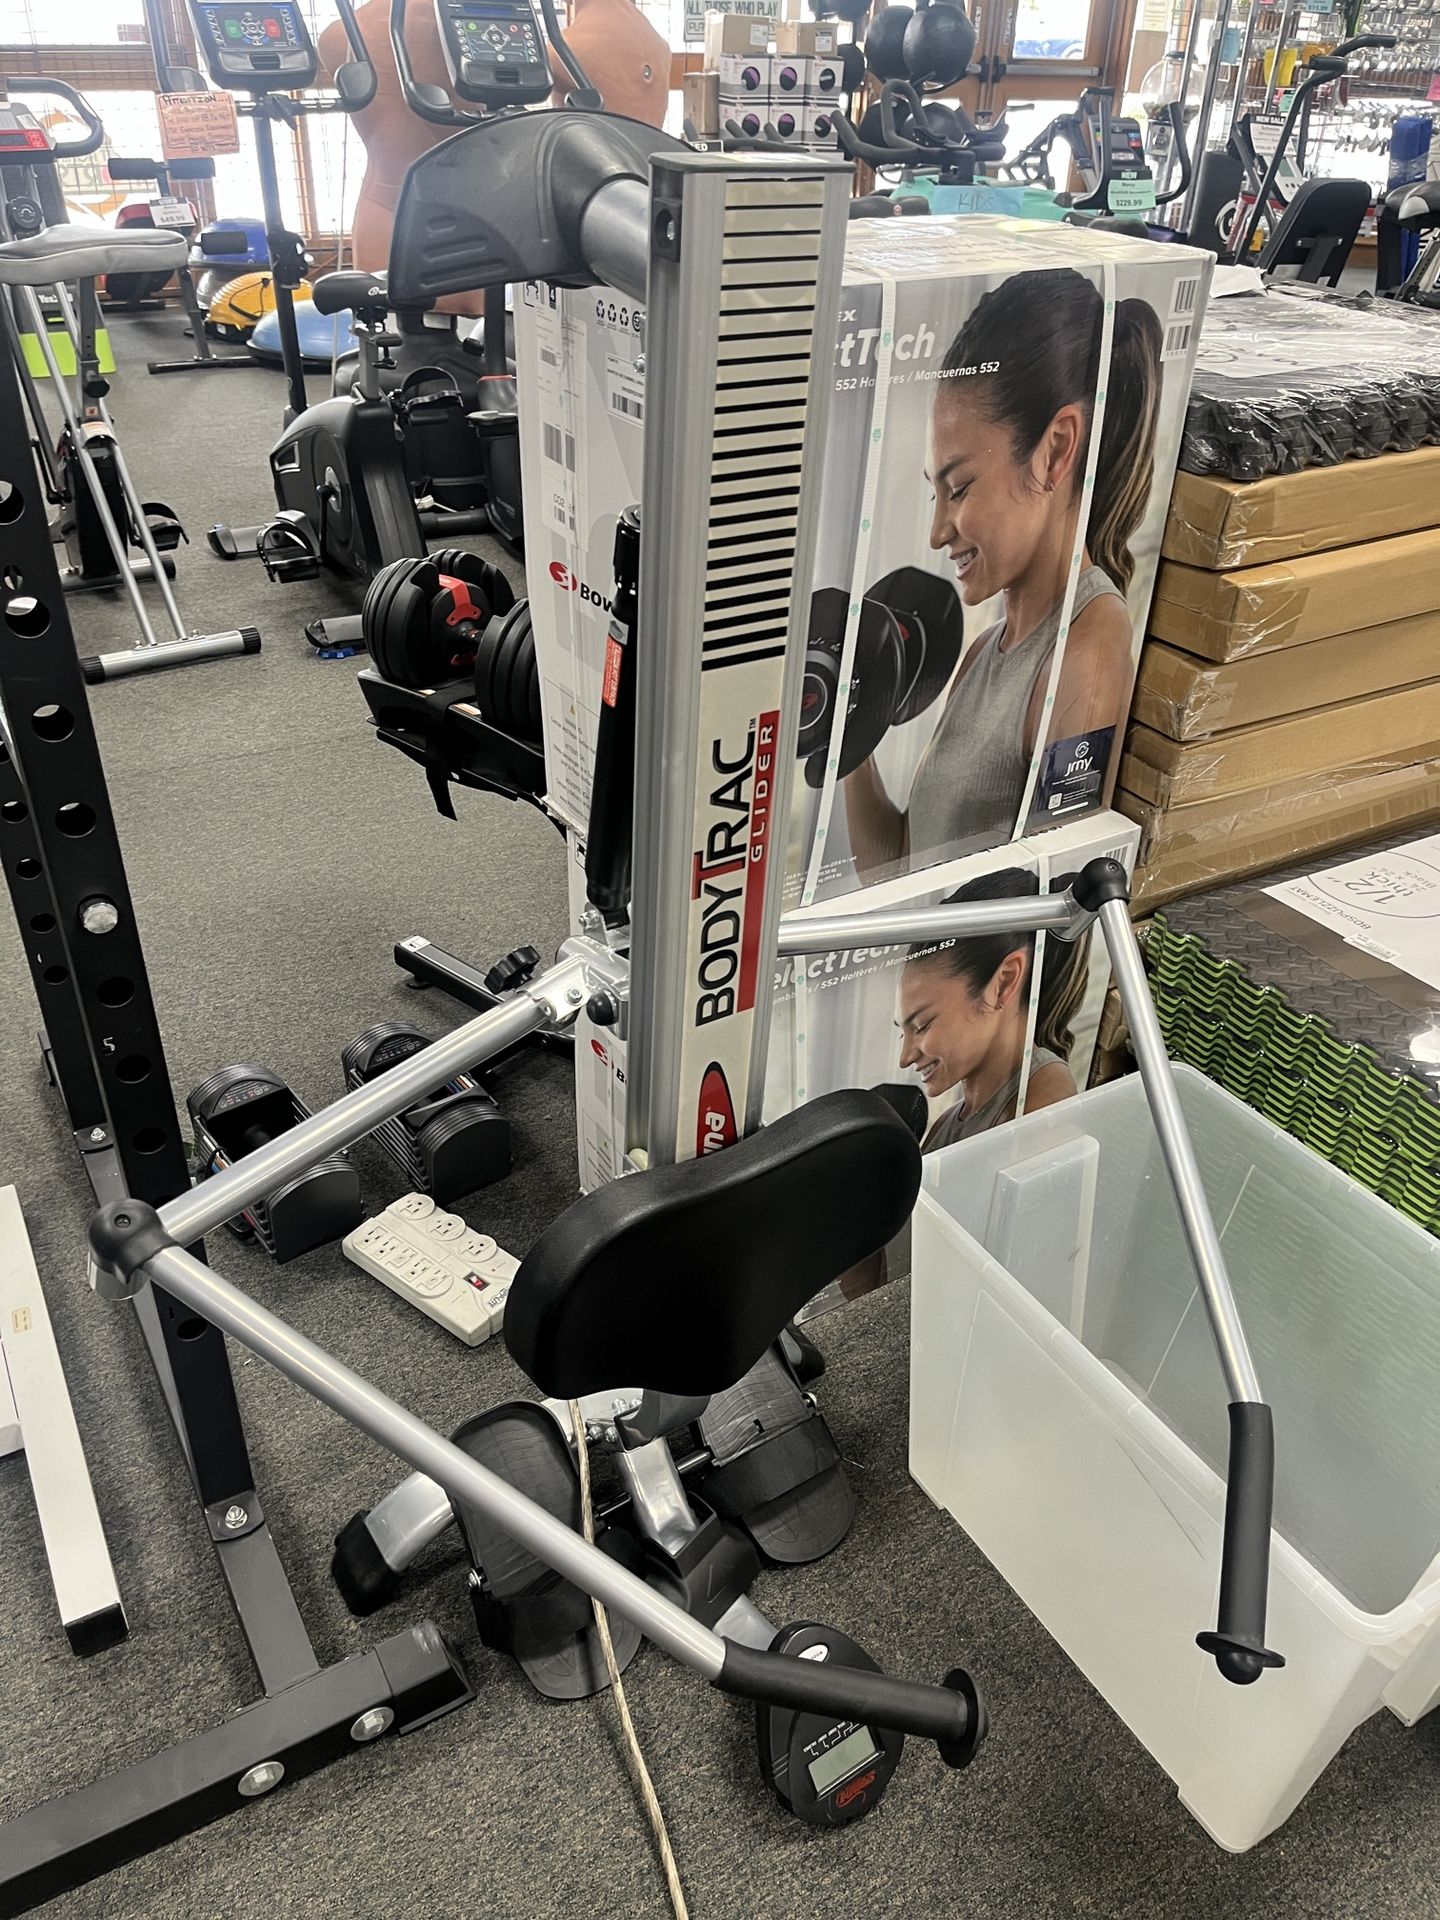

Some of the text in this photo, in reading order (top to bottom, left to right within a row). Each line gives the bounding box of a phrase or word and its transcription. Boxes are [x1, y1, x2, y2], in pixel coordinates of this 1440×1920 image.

[735, 1, 755, 15] WHO
[757, 1, 779, 16] PLAY
[1121, 171, 1137, 179] NEW
[958, 192, 994, 211] KIDS
[835, 377, 857, 391] 552
[859, 374, 905, 389] Hares
[914, 365, 977, 382] Mancuernas
[979, 361, 1001, 374] 552
[750, 724, 774, 864] GLIDER
[1364, 871, 1414, 897] thick
[821, 977, 839, 990] 552
[840, 965, 878, 983] Haltères
[885, 945, 937, 968] Mancuernas
[938, 938, 956, 951] 552
[101, 1036, 117, 1054] 5
